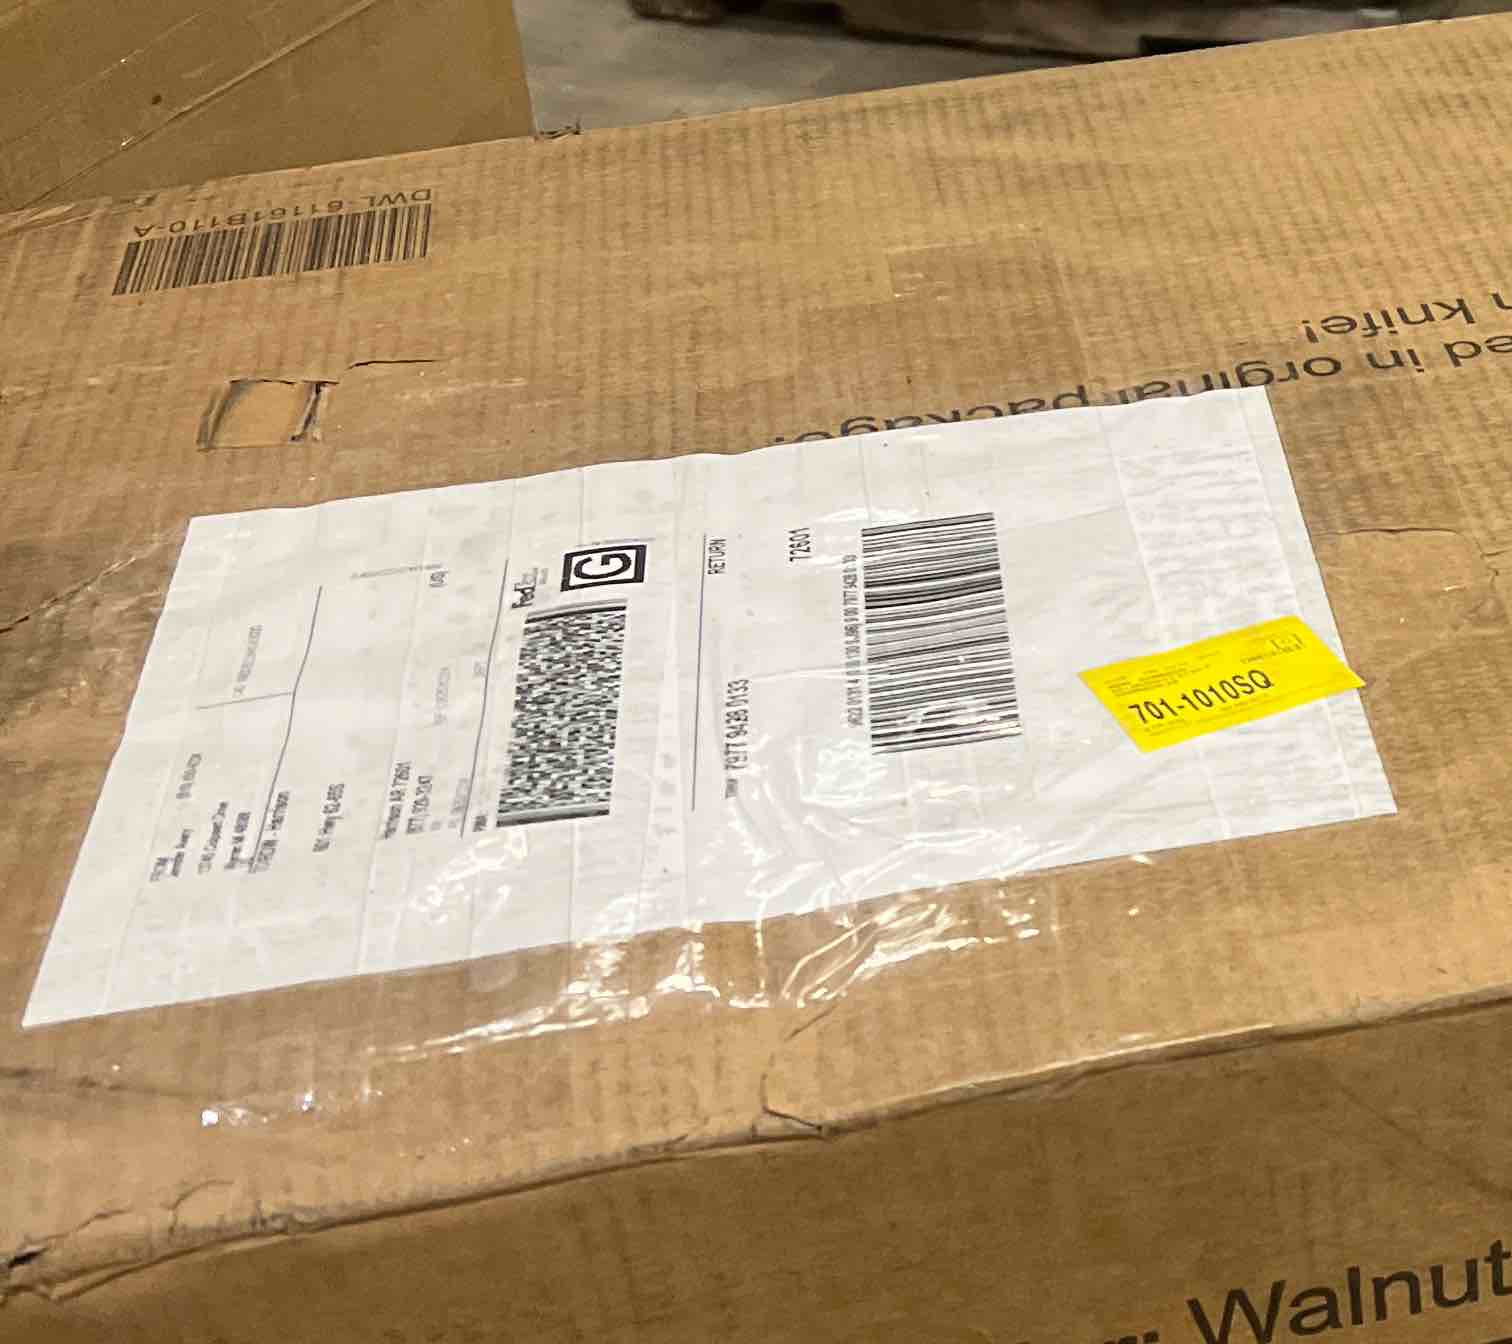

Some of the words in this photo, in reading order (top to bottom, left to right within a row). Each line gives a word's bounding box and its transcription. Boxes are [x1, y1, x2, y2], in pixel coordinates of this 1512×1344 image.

[1300, 296, 1476, 343] knife!
[1367, 347, 1426, 373] in
[707, 537, 727, 575] RETURN
[788, 526, 812, 563] 72601
[573, 554, 632, 580] G
[726, 678, 749, 708] 0133
[1128, 669, 1275, 725] 701-1010SQ
